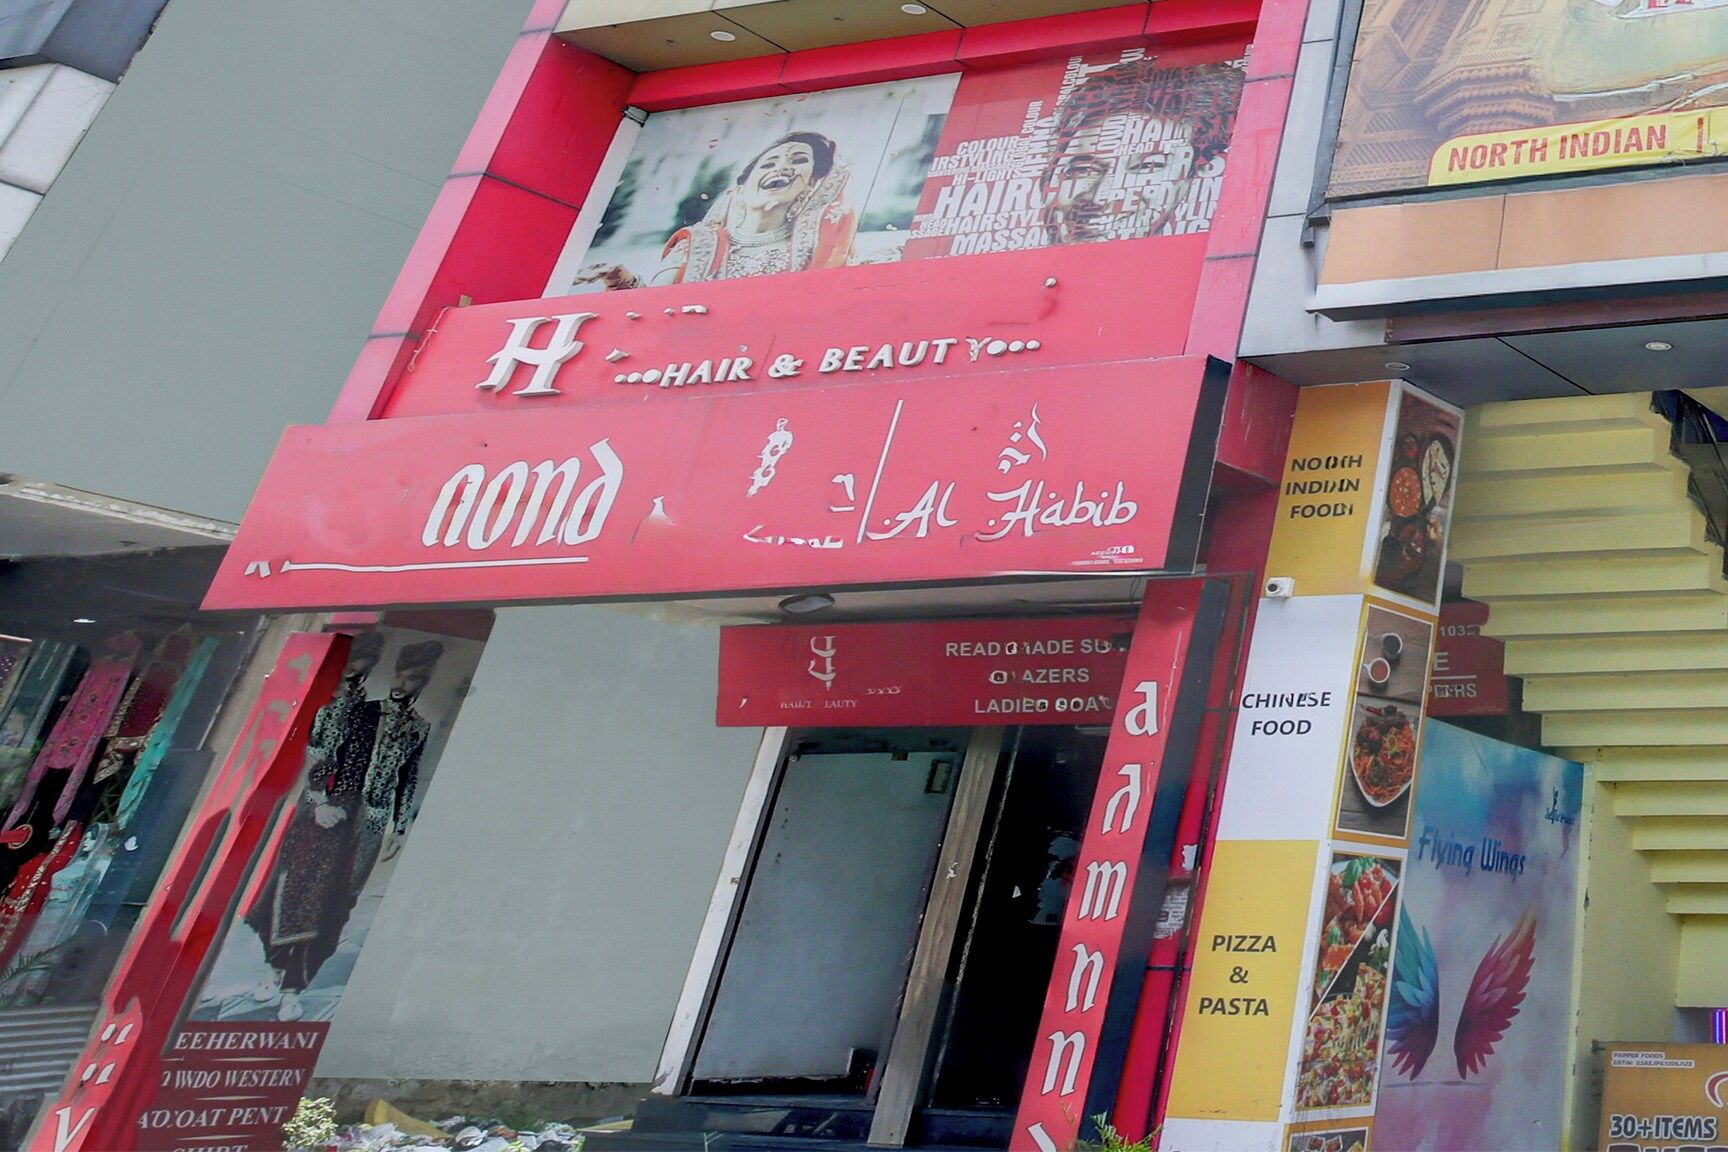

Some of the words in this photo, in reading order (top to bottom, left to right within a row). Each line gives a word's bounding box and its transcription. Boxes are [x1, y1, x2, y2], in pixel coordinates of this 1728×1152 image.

[1447, 137, 1548, 172] NORTH
[1558, 123, 1668, 160] INDIAN
[768, 354, 804, 378] &
[866, 480, 958, 541] Al
[975, 479, 1138, 542] Habib
[1241, 691, 1332, 709] CHINESE
[1251, 719, 1312, 736] FOOD
[1417, 824, 1475, 877] Flying
[1479, 836, 1526, 884] Wings
[1211, 934, 1278, 953] PIZZA
[1229, 965, 1249, 984] &
[1198, 996, 1270, 1017] PASTA
[226, 1105, 288, 1127] PENT
